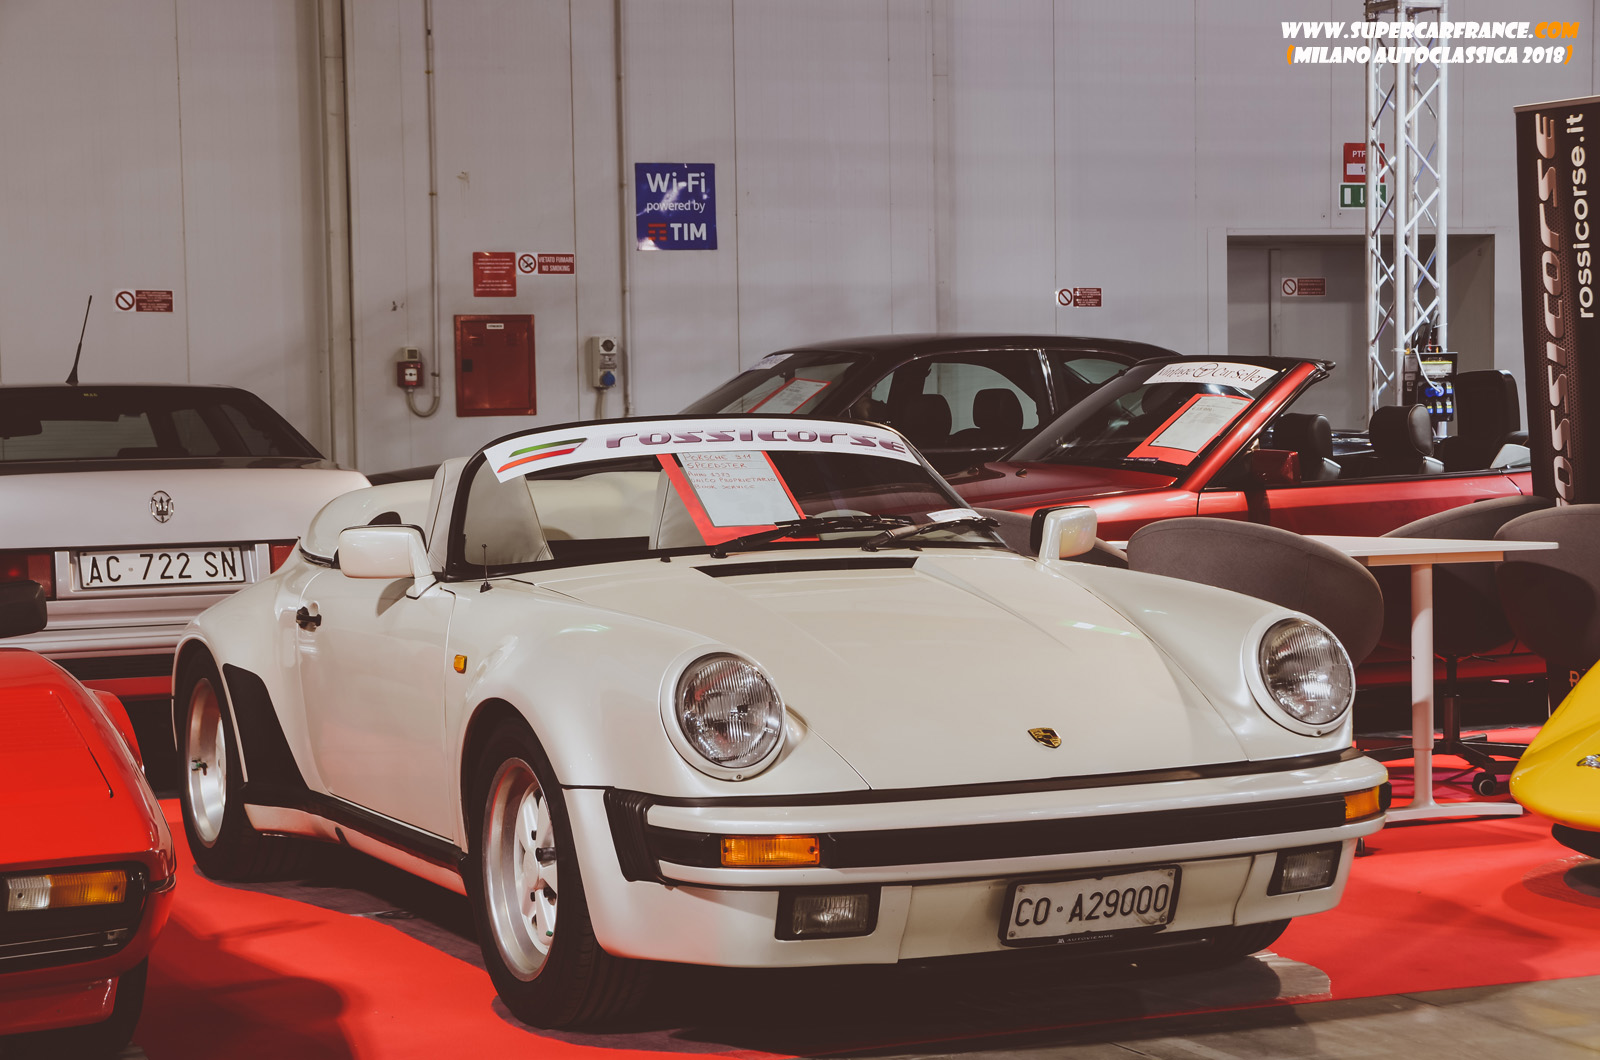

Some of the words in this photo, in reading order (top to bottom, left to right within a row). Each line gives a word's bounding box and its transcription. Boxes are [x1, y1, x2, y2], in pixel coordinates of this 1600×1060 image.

[646, 172, 706, 193] Wi-Fi
[646, 200, 691, 213] powered
[693, 200, 706, 213] by
[1566, 113, 1594, 318] rossicorse.it
[670, 223, 707, 241] TIM
[556, 256, 574, 264] FUMARE
[1535, 113, 1574, 506] ossicorse
[606, 427, 906, 454] rossicorse
[682, 452, 728, 461] PORSCHE
[90, 555, 122, 583] AC
[139, 552, 192, 581] 722
[204, 550, 236, 578] SN
